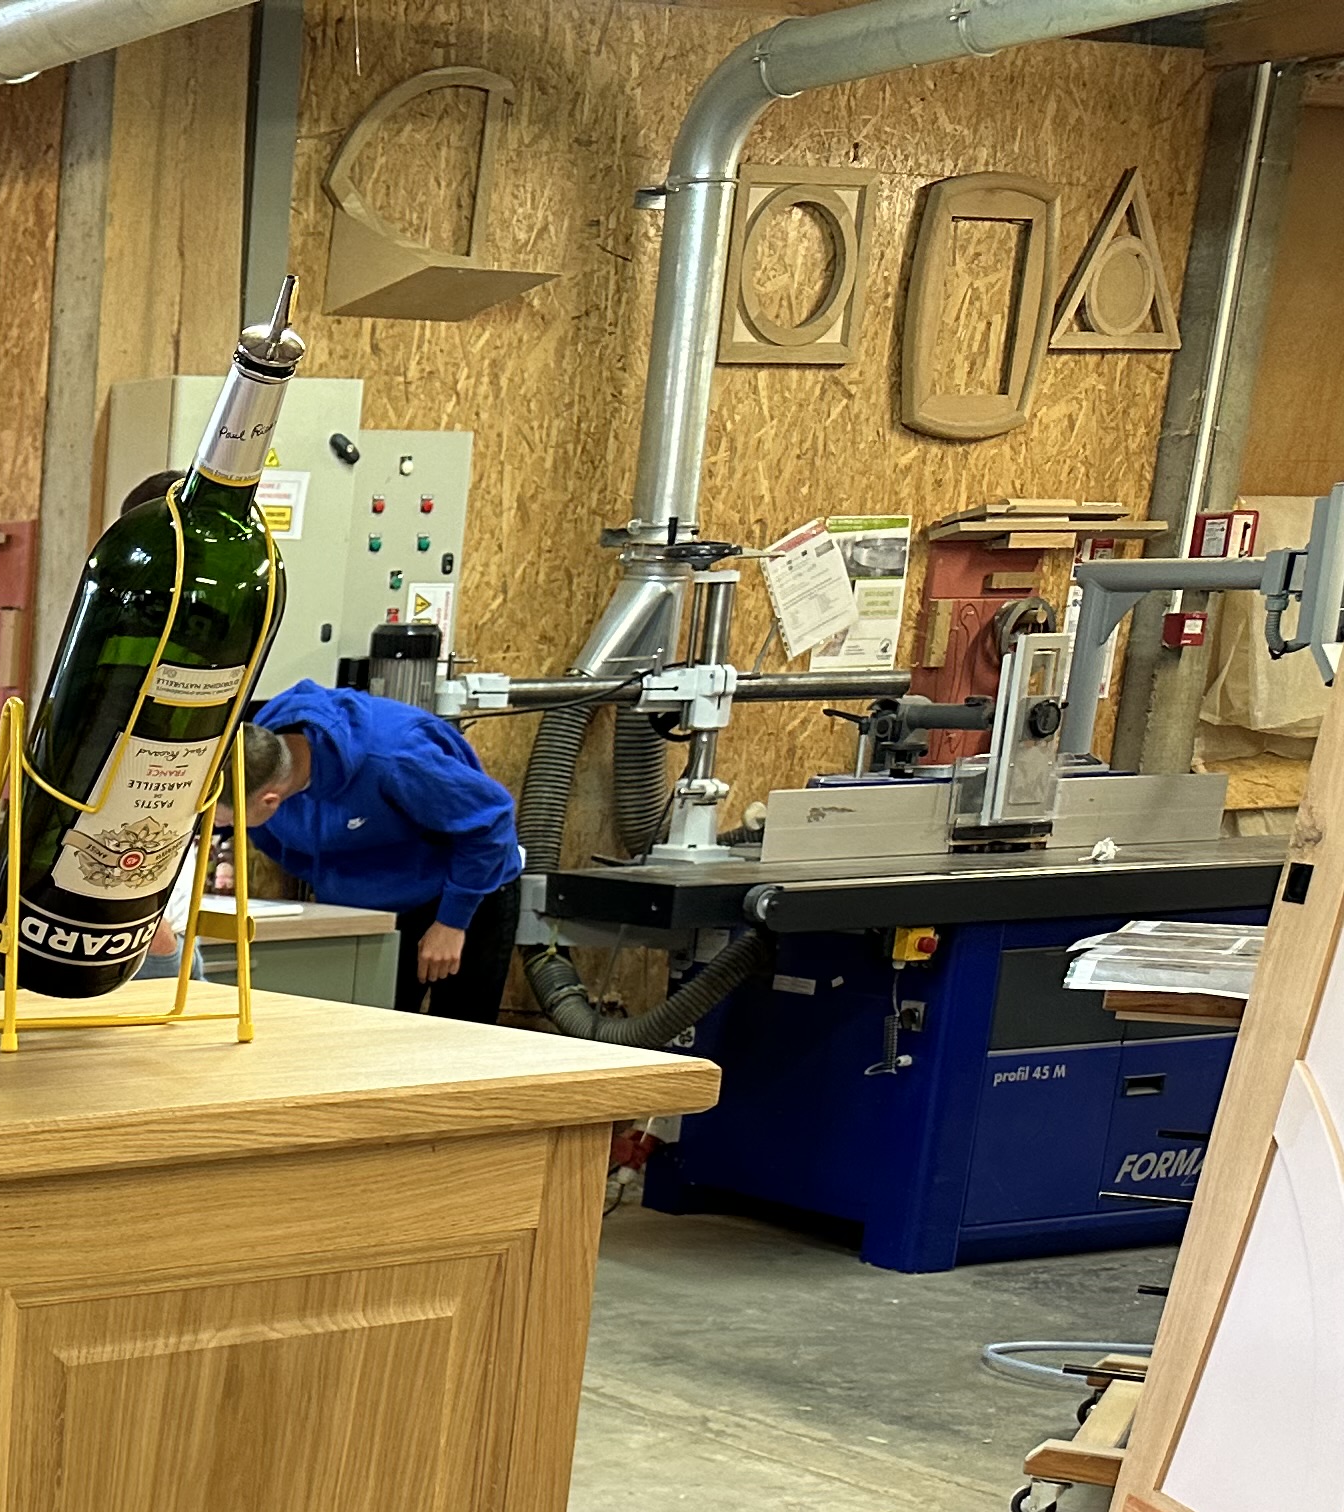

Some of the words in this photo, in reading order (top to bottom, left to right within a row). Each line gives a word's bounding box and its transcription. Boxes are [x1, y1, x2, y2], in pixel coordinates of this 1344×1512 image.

[218, 425, 246, 441] Paul
[135, 748, 179, 761] Ricard
[146, 769, 186, 777] FRANCE
[127, 779, 193, 791] MARSEILLE
[134, 800, 174, 809] PASTIS
[21, 915, 162, 956] RICARD
[993, 1066, 1029, 1087] profil
[1032, 1066, 1050, 1080] 45
[1053, 1064, 1066, 1079] M
